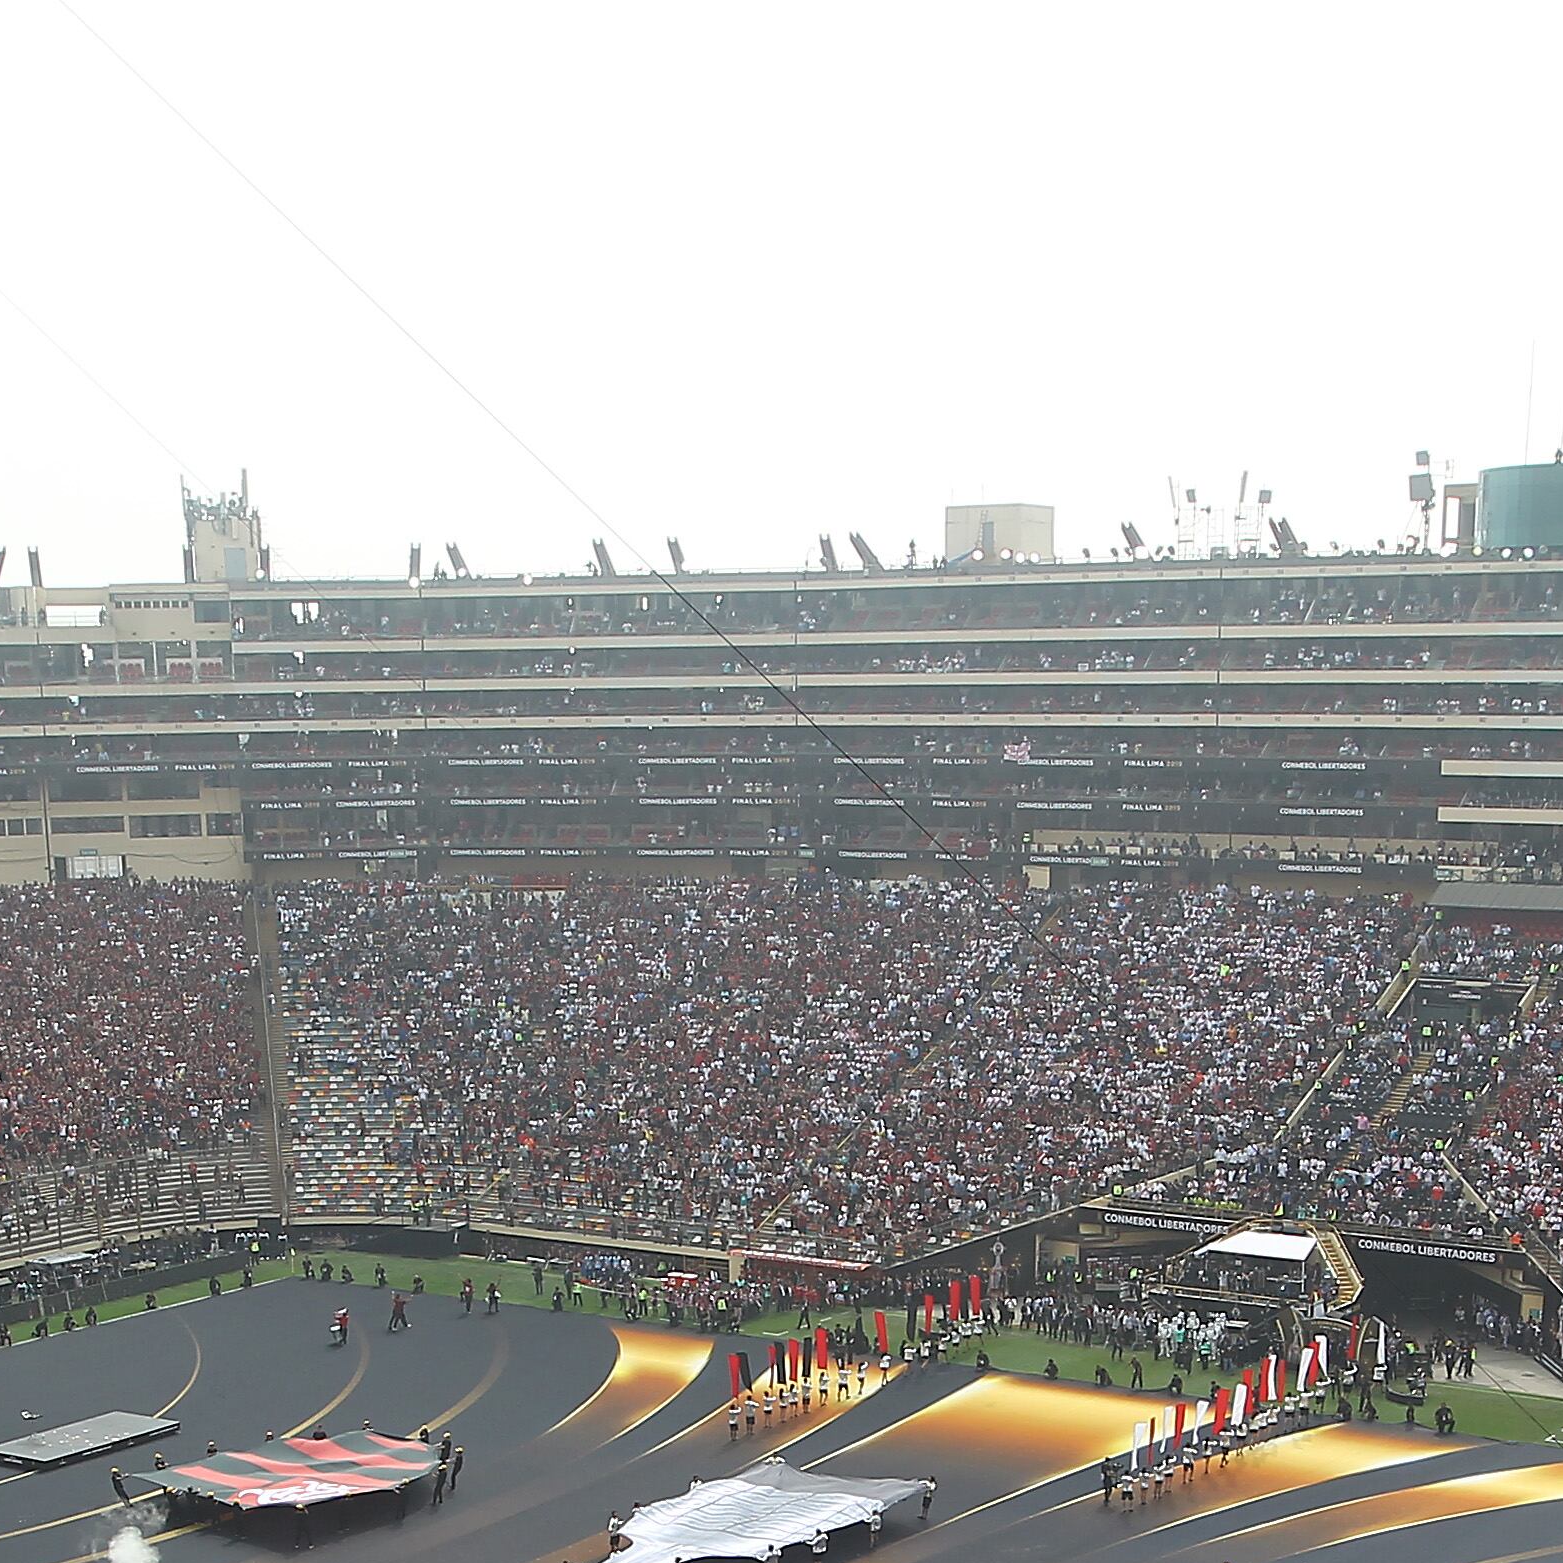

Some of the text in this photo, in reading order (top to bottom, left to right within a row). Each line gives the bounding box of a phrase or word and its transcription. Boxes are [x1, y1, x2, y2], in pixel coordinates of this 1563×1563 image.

[447, 758, 484, 766] CONMEBOL
[637, 756, 717, 765] CONMEBOL LIBERTADORES
[76, 765, 159, 774] CONMEBOL LIBERTADORES
[251, 761, 333, 770] CONMEBOL LIBERTADORES
[1281, 761, 1366, 770] CONMEBOL LIBERTADORES
[335, 799, 416, 808] CONMEBOL LIBERTADORES
[449, 798, 527, 806] CONMEBOL LIBERTADORES
[638, 797, 717, 805] CONMEBOL LIBERTADORES
[1016, 802, 1093, 810] CONMEBOL LIBERTADORES
[1279, 807, 1364, 817] CONMEBOL LIBERTADORES
[449, 848, 485, 856] CONMEBOL
[636, 848, 715, 857] CONMEBOL LIBERTADORES
[1277, 864, 1362, 874] CONMEBOL LIBERTADORES
[1104, 1212, 1229, 1236] CONMEBOL LIBERTADORES
[1358, 1238, 1496, 1263] CONMEBOL LIBERTADORES
